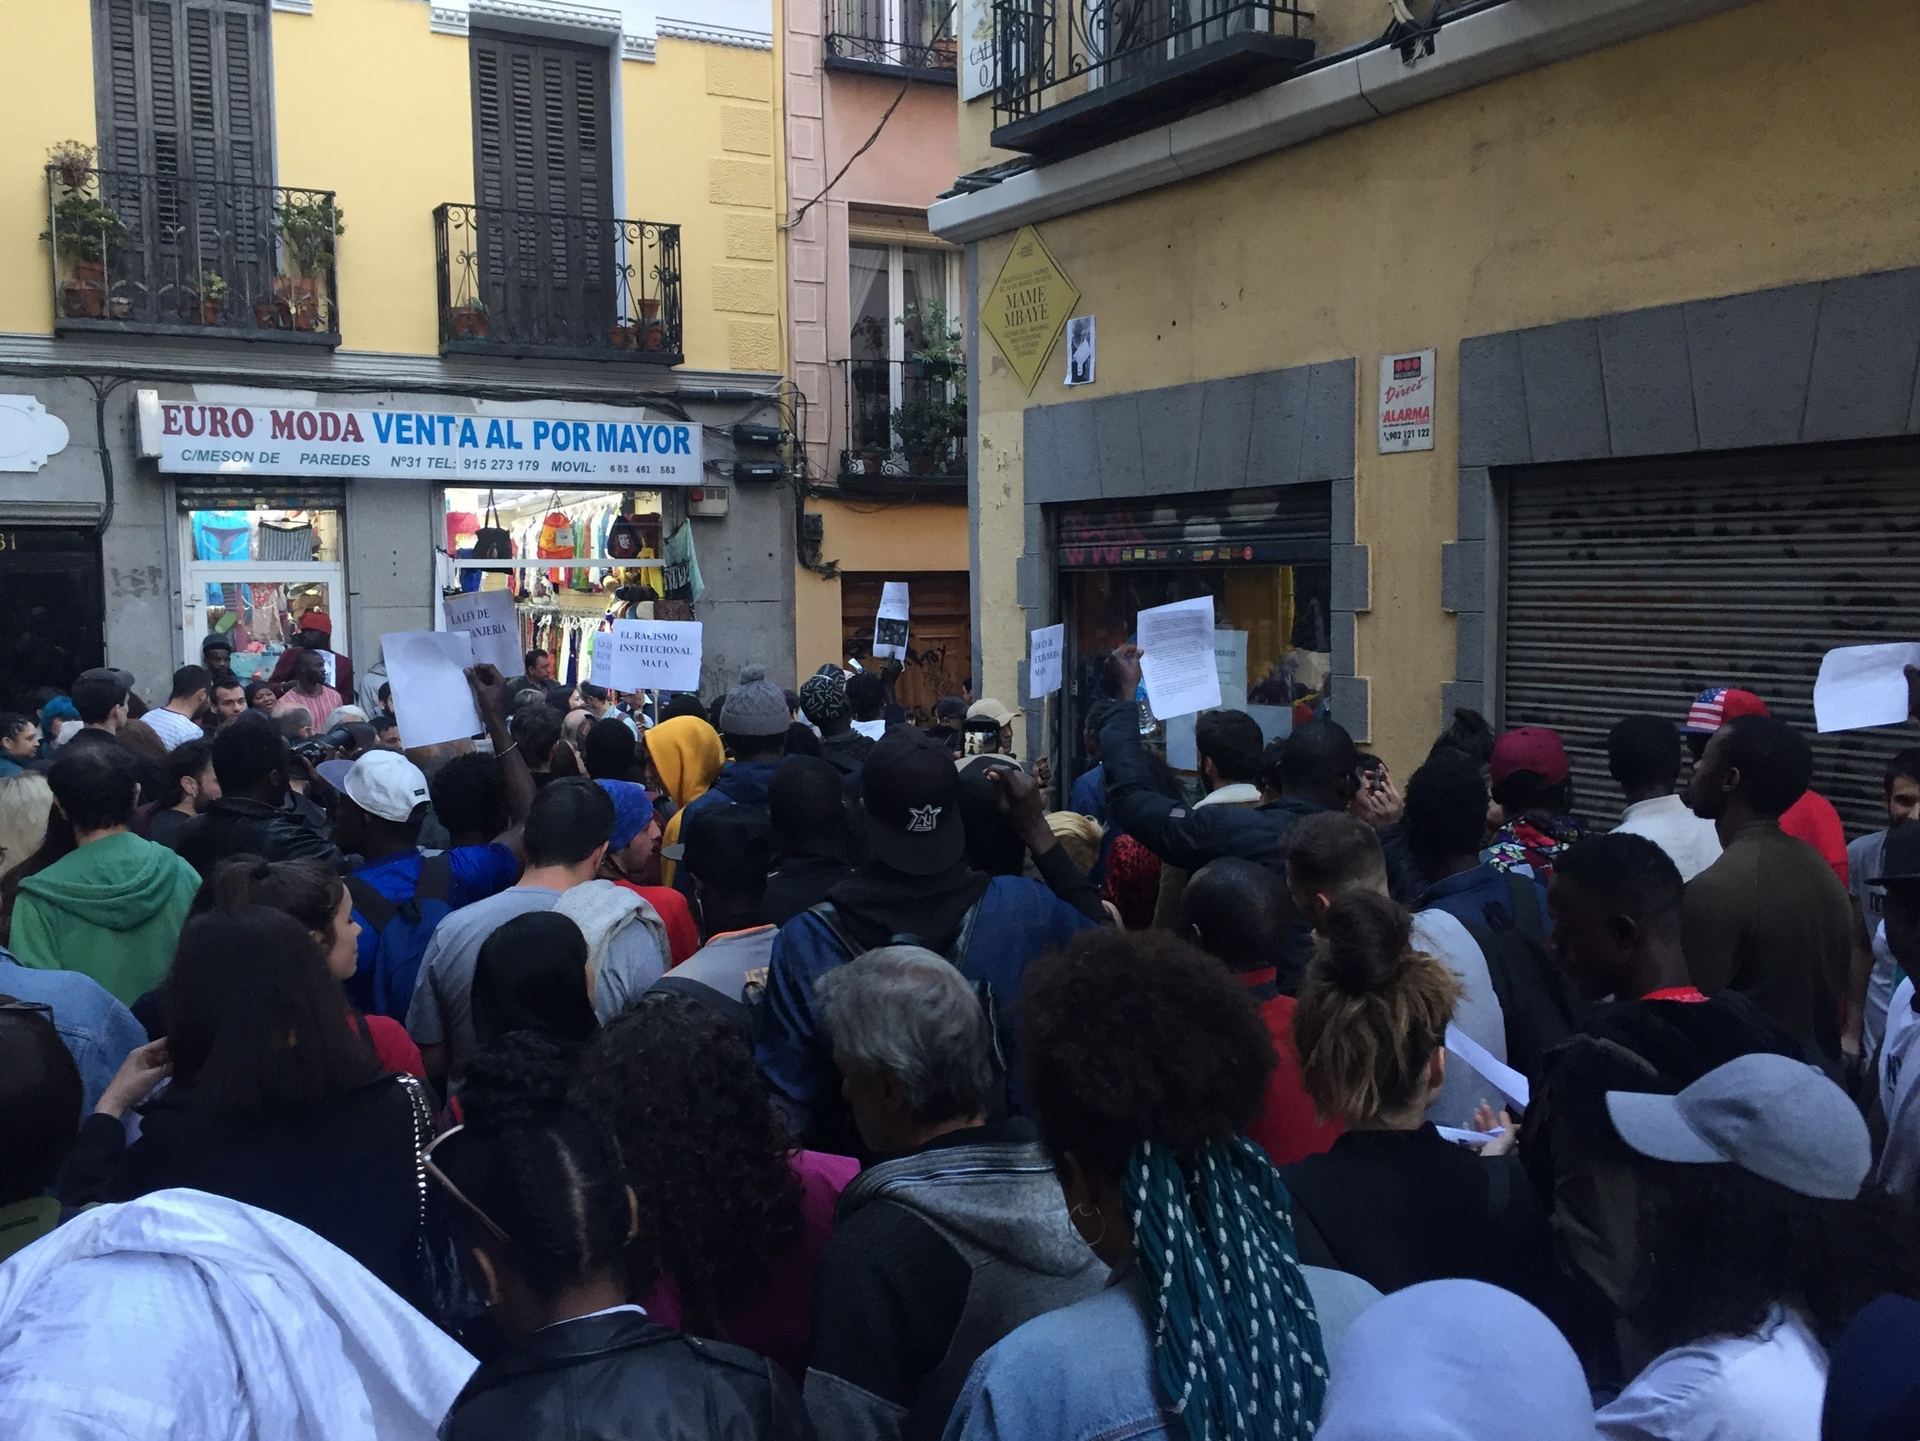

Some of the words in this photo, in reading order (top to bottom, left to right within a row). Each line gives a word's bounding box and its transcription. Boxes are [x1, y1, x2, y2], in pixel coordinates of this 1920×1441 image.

[1006, 286, 1047, 310] MAME
[1004, 304, 1049, 328] MBAYE
[1384, 376, 1427, 404] Direct
[1383, 406, 1429, 423] ALARMA
[161, 405, 254, 438] EURO
[270, 410, 364, 443] MODA
[372, 412, 479, 448] VENTA
[485, 419, 523, 450] AL
[533, 421, 591, 452] POR
[596, 423, 691, 455] MAYOR
[1389, 431, 1401, 440] 902
[1404, 430, 1415, 438] 121
[1418, 428, 1429, 437] 122
[181, 449, 254, 464] C/MESON
[259, 452, 281, 464] DE
[300, 453, 370, 466] PAREDES
[427, 457, 457, 469] TEL:
[463, 459, 487, 470] 915
[490, 460, 513, 471] 273
[518, 460, 540, 471] 179
[551, 461, 596, 473] MOVIL:
[477, 608, 490, 620] DE
[620, 631, 632, 639] EL
[634, 632, 678, 641] RACISMO
[619, 644, 693, 655] INSTITUCIONAL
[641, 659, 669, 668] MATA
